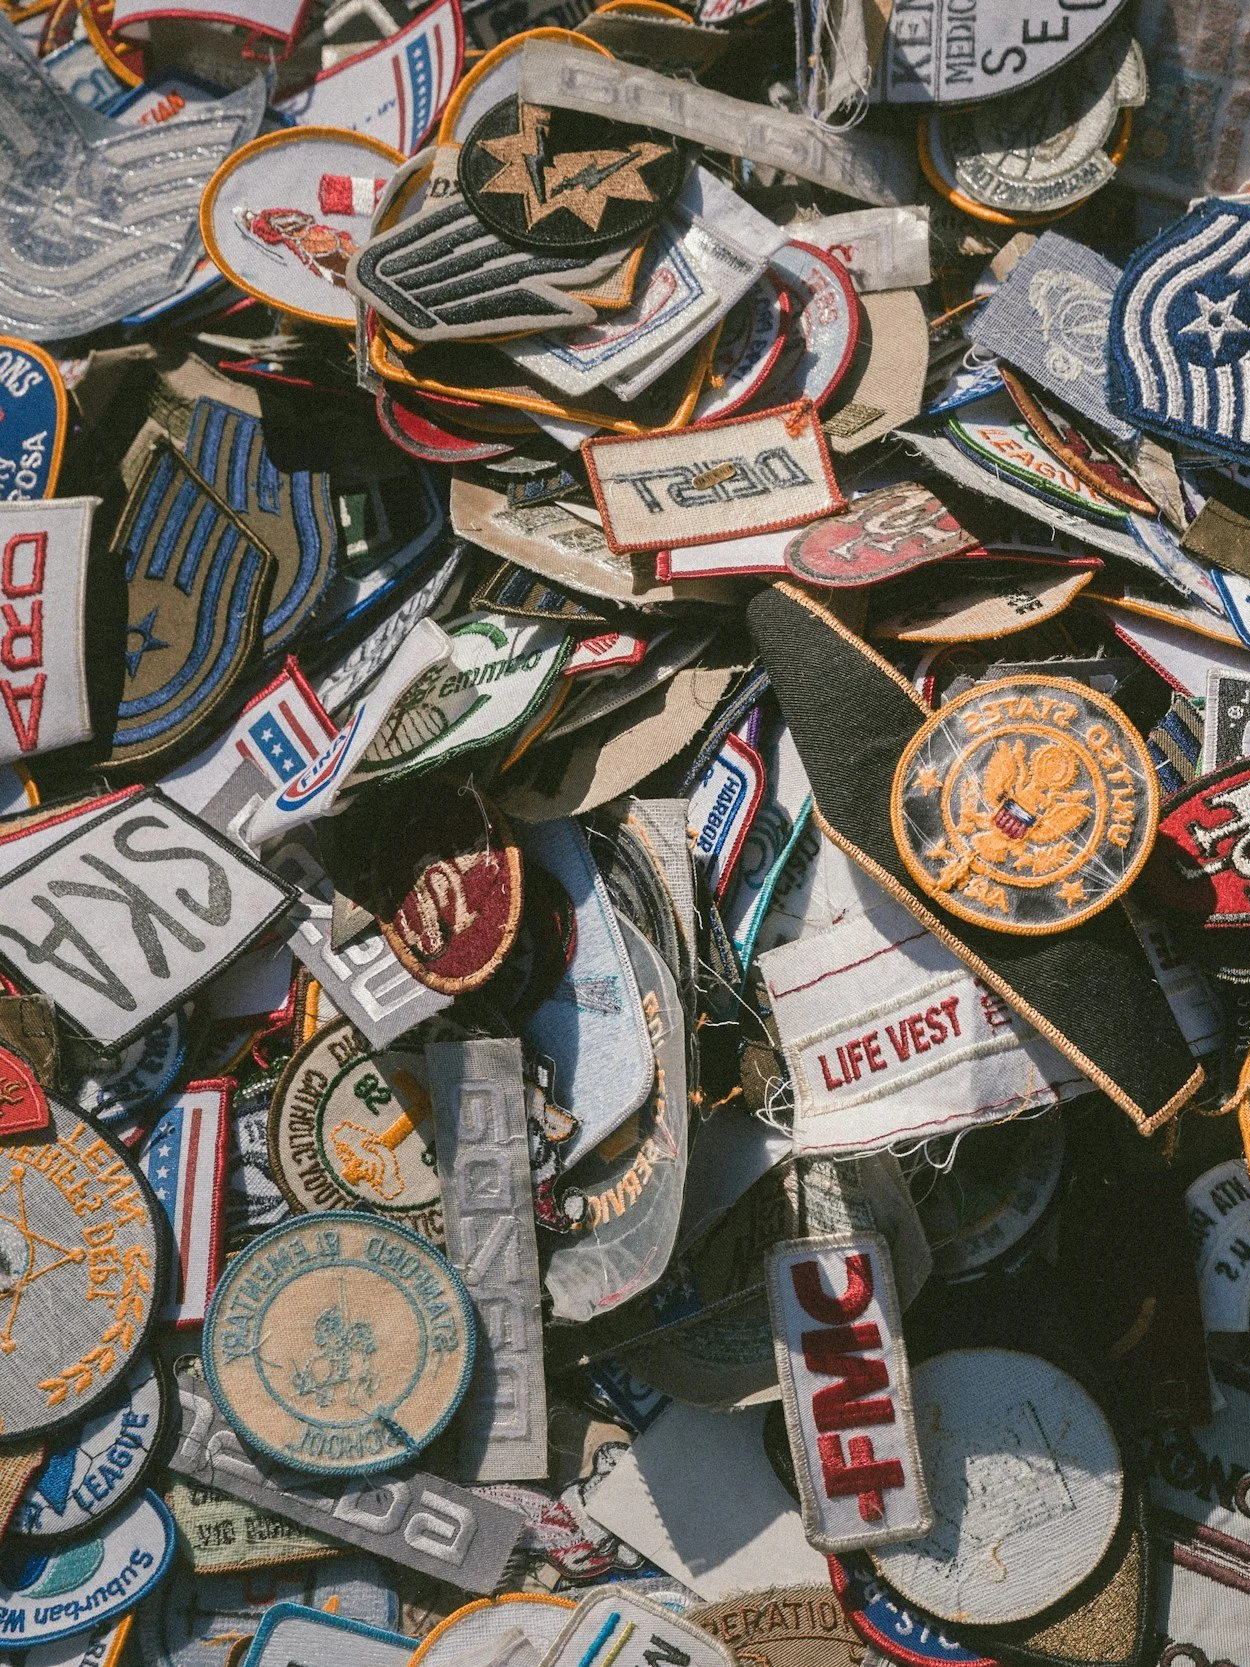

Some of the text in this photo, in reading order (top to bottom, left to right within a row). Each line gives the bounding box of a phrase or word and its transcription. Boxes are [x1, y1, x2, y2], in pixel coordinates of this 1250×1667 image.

[299, 730, 348, 790] FINA
[697, 775, 742, 855] HARBOR
[817, 1028, 889, 1092] LIFE
[887, 995, 961, 1062] VEST
[287, 1068, 329, 1169] CATHOLIC
[789, 1250, 906, 1523] FMC
[71, 1410, 150, 1510] LEAGUE
[34, 1547, 155, 1624] Suburban
